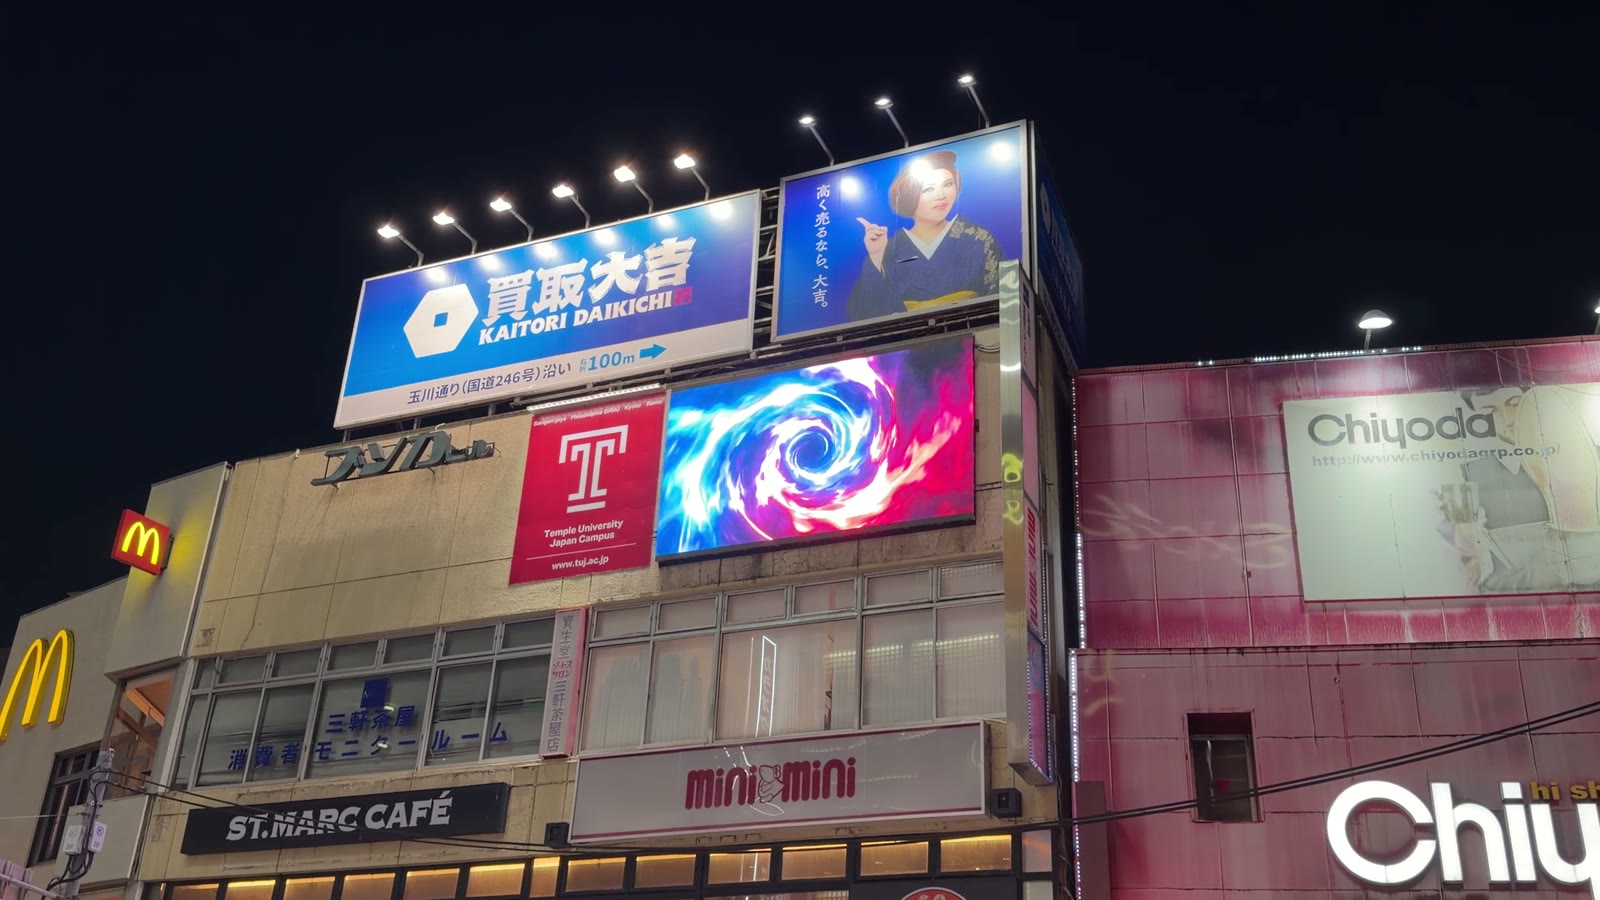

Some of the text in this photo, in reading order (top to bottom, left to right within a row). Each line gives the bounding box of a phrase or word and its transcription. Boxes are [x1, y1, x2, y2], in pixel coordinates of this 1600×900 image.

[812, 183, 831, 308] 高く売るなら、大吉。
[482, 236, 697, 327] 買取大吉
[478, 313, 567, 346] KAITORI
[573, 290, 673, 327] DAIKICHI
[588, 351, 635, 371] 100m
[407, 362, 572, 405] 玉川通り(国道246号)沿い
[570, 409, 603, 421] Philadelphia
[624, 402, 642, 411] Kyoto
[1308, 407, 1497, 449] Chiyoda
[544, 519, 624, 538] Temple University
[549, 531, 615, 548] Japan Campus
[551, 554, 609, 571] www.tuj.ac.jp
[558, 615, 574, 659] 資生堂
[325, 705, 417, 735] 三軒茶屋
[547, 680, 567, 753] 三軒茶屋店
[685, 756, 856, 810] mini mini
[1530, 781, 1561, 800] hi
[365, 790, 453, 829] CAFÉ
